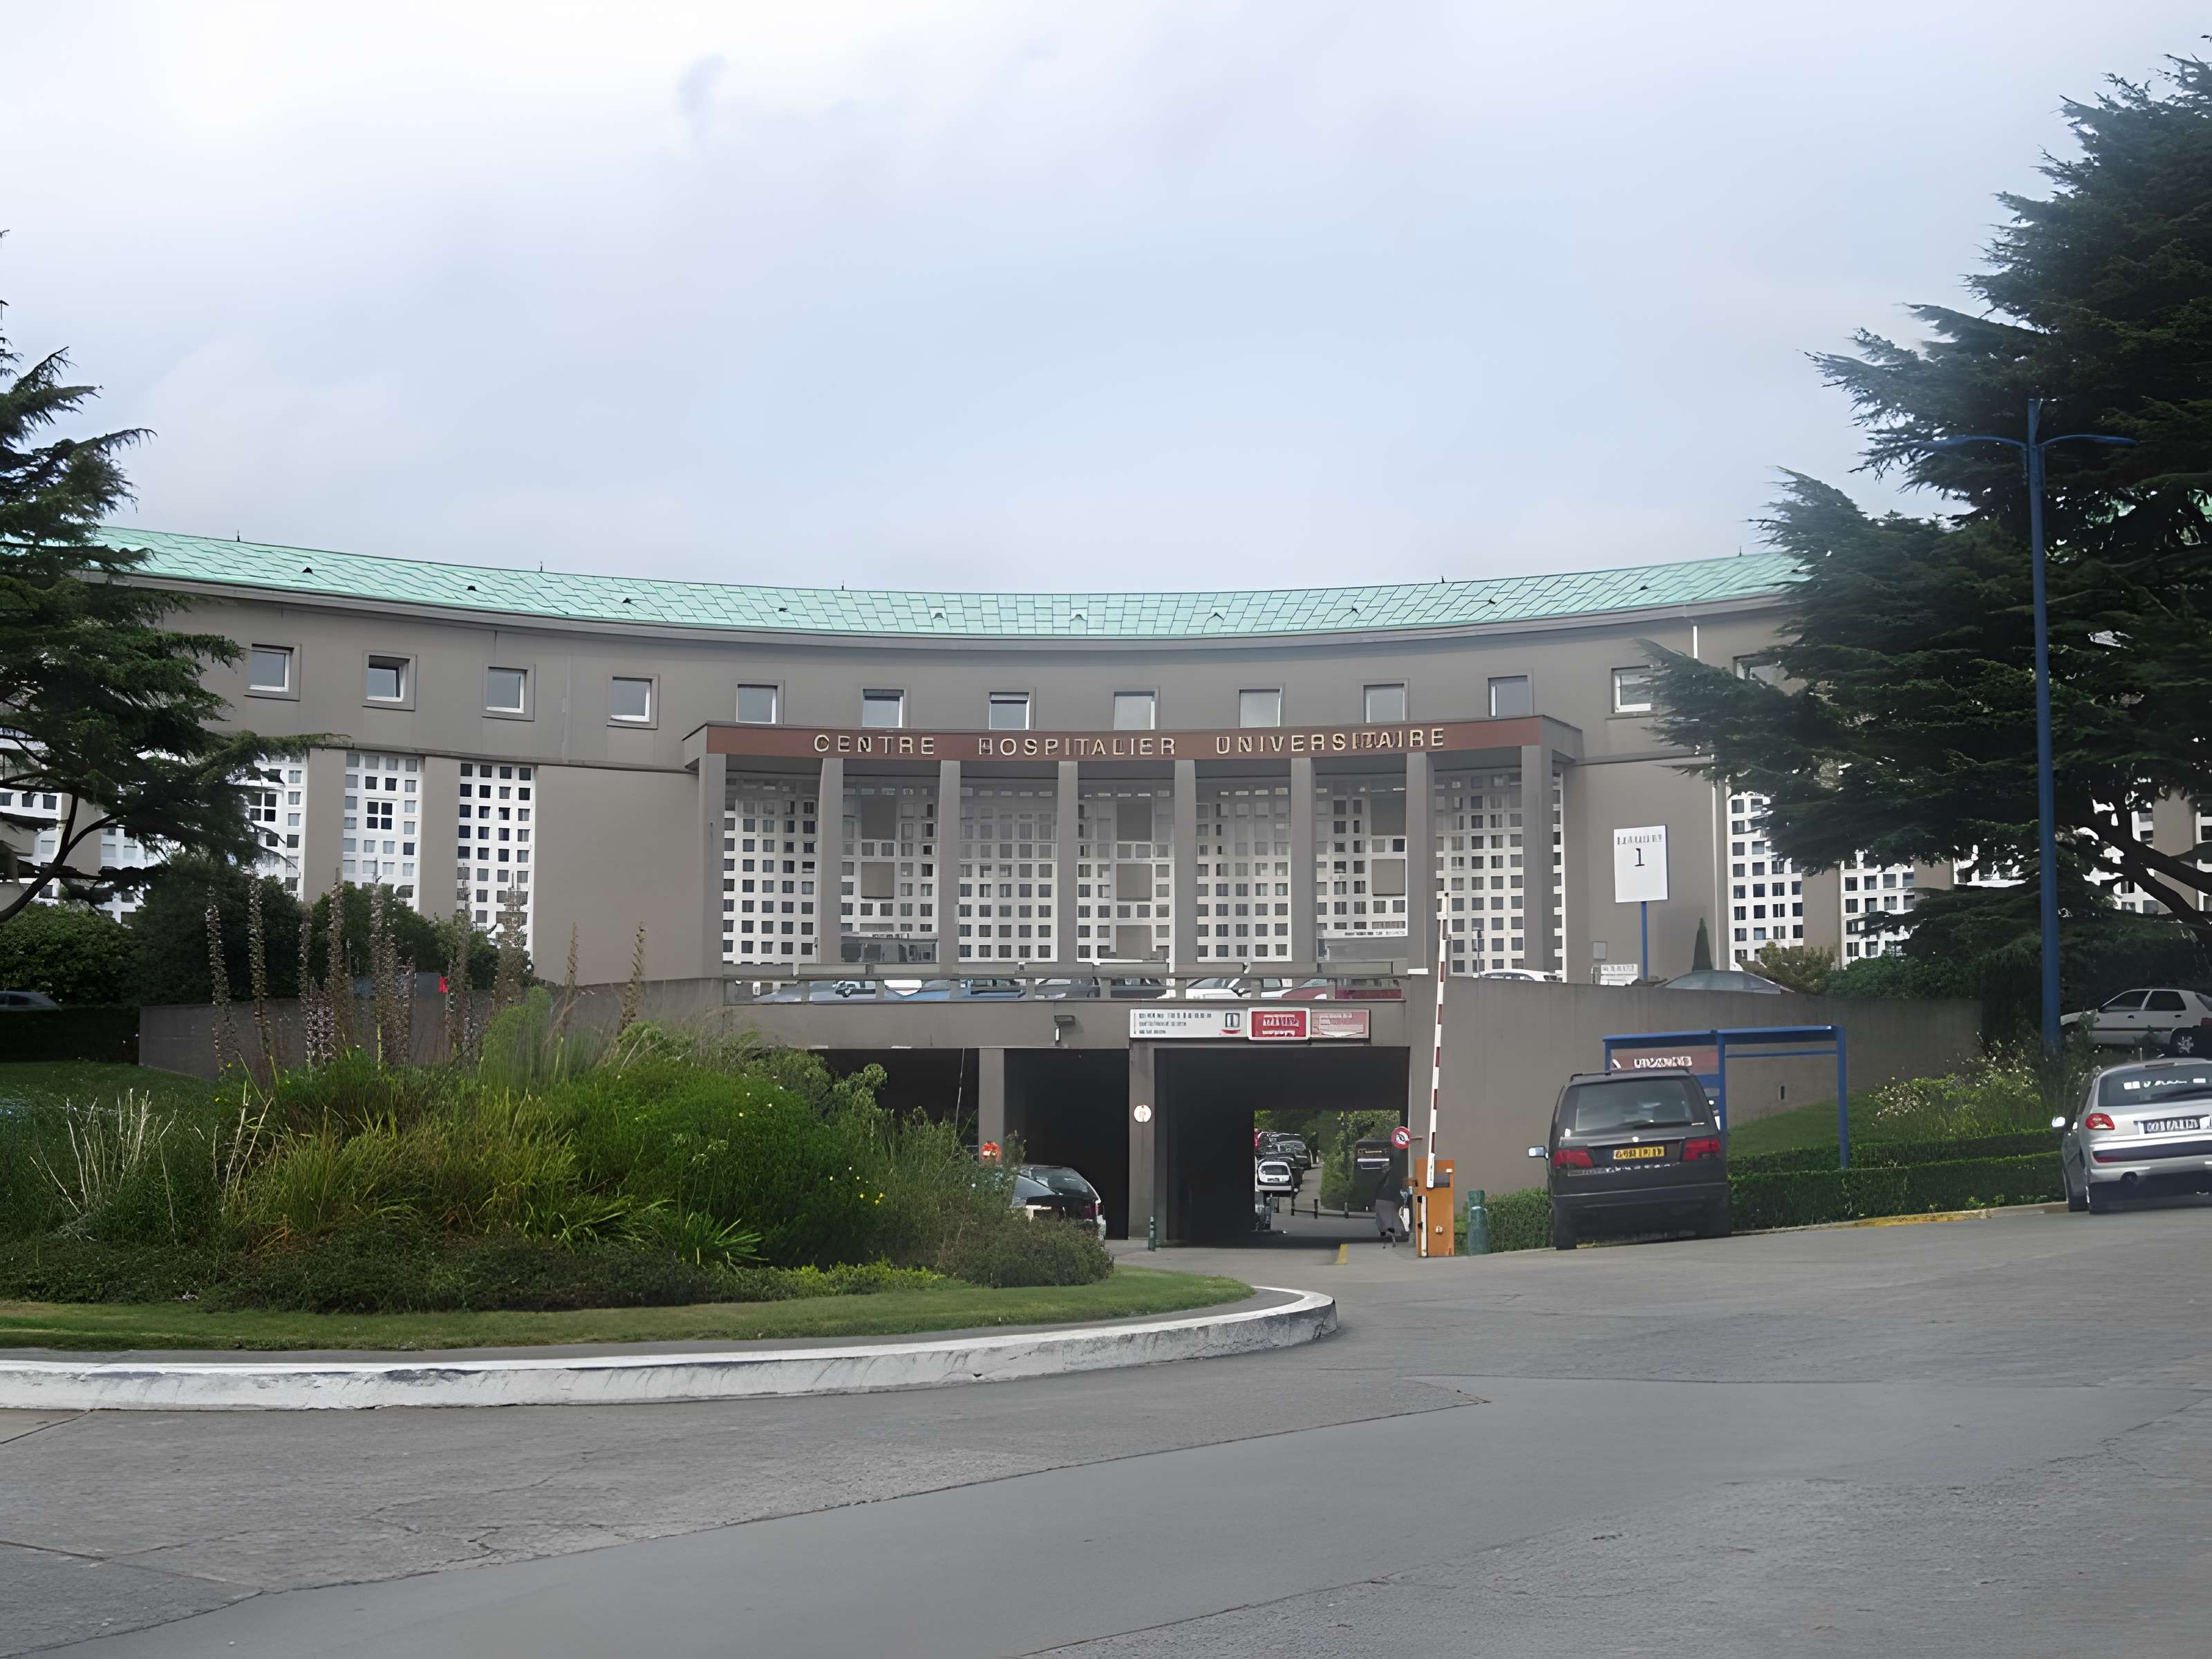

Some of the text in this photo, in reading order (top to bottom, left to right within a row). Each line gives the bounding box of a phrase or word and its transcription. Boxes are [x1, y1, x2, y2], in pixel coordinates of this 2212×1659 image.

[814, 728, 1444, 756] CENTRE HOSPITALIER UNIVERSITAIRE
[1634, 847, 1646, 868] 1
